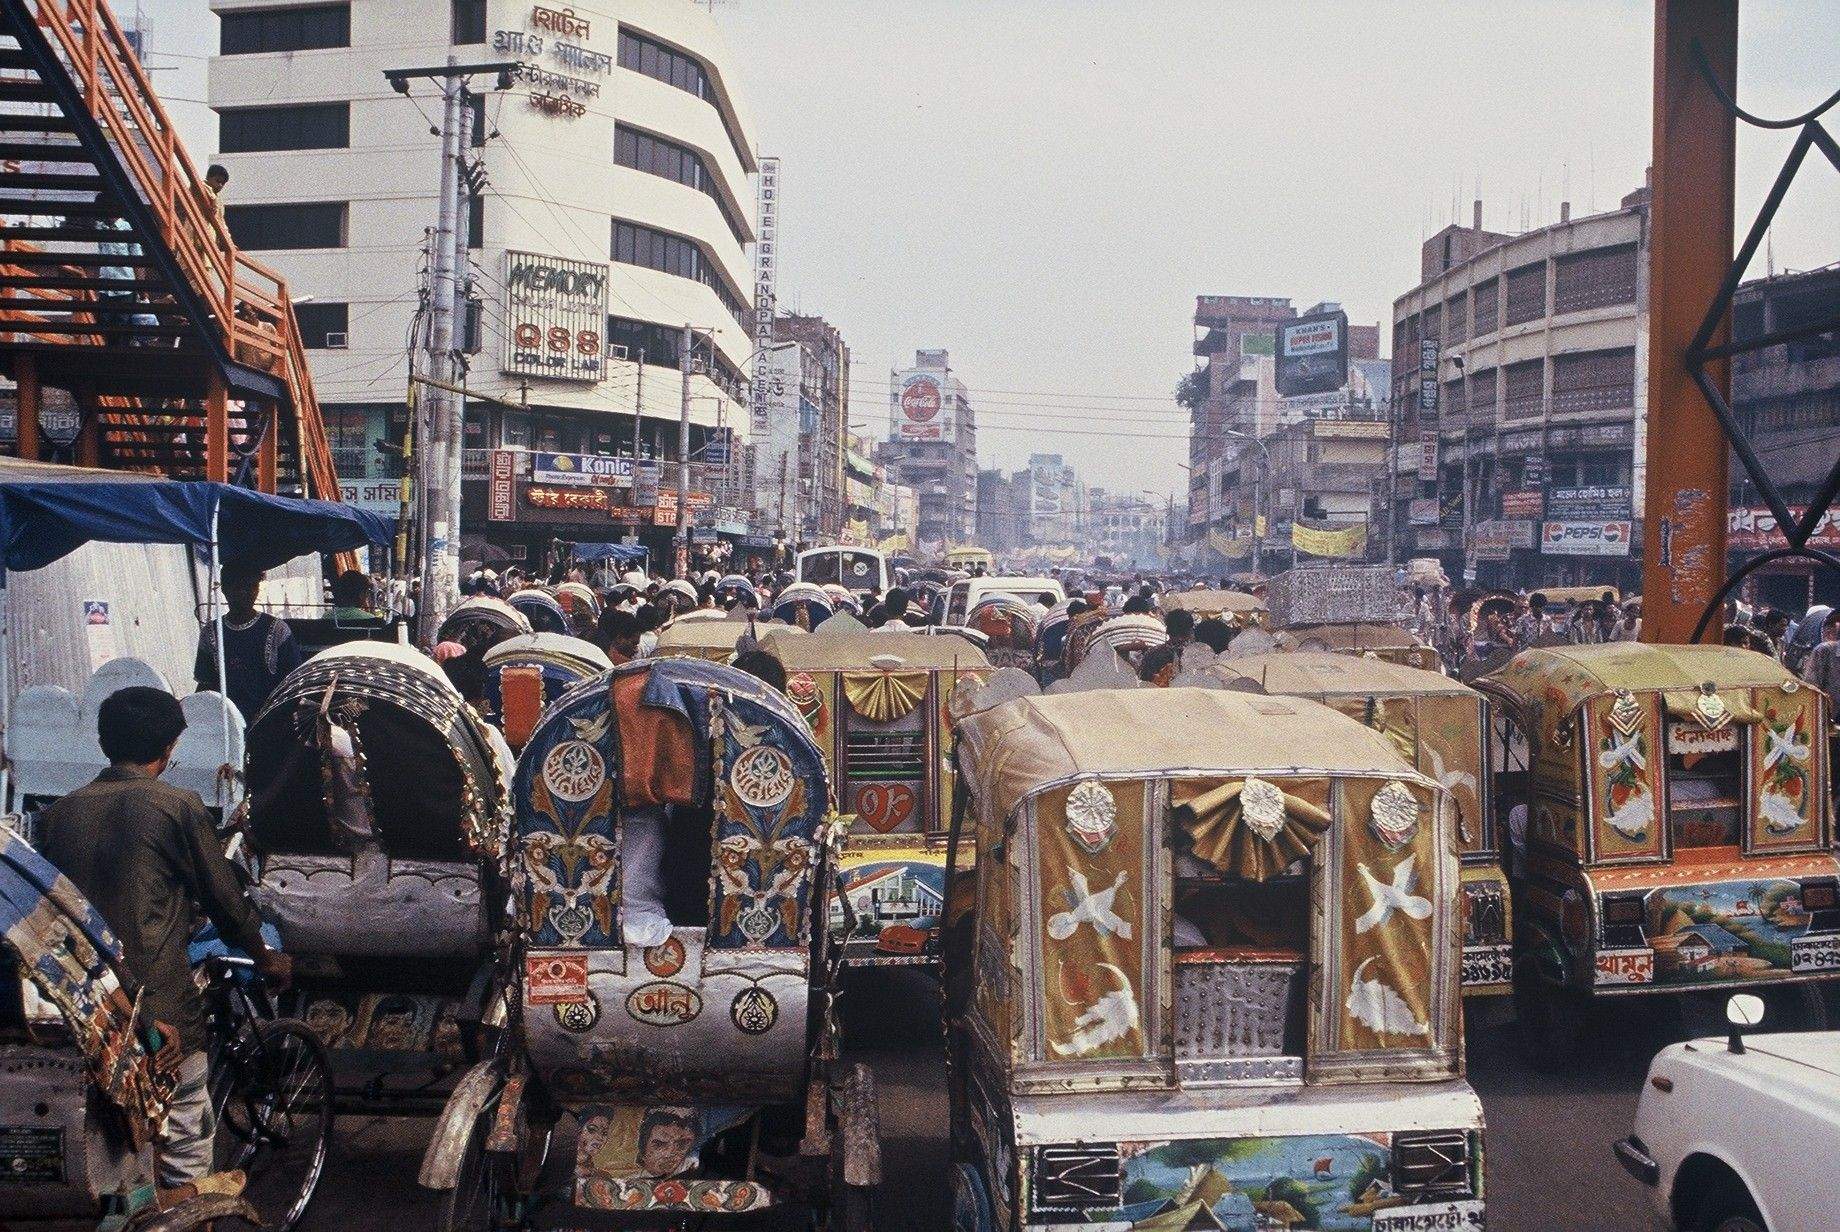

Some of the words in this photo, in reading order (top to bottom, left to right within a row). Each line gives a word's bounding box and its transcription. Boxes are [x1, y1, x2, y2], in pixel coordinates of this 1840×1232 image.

[762, 176, 774, 241] HOTEL
[509, 262, 606, 299] MEMORY
[581, 457, 633, 475] Konic
[1564, 527, 1603, 540] PEPSI
